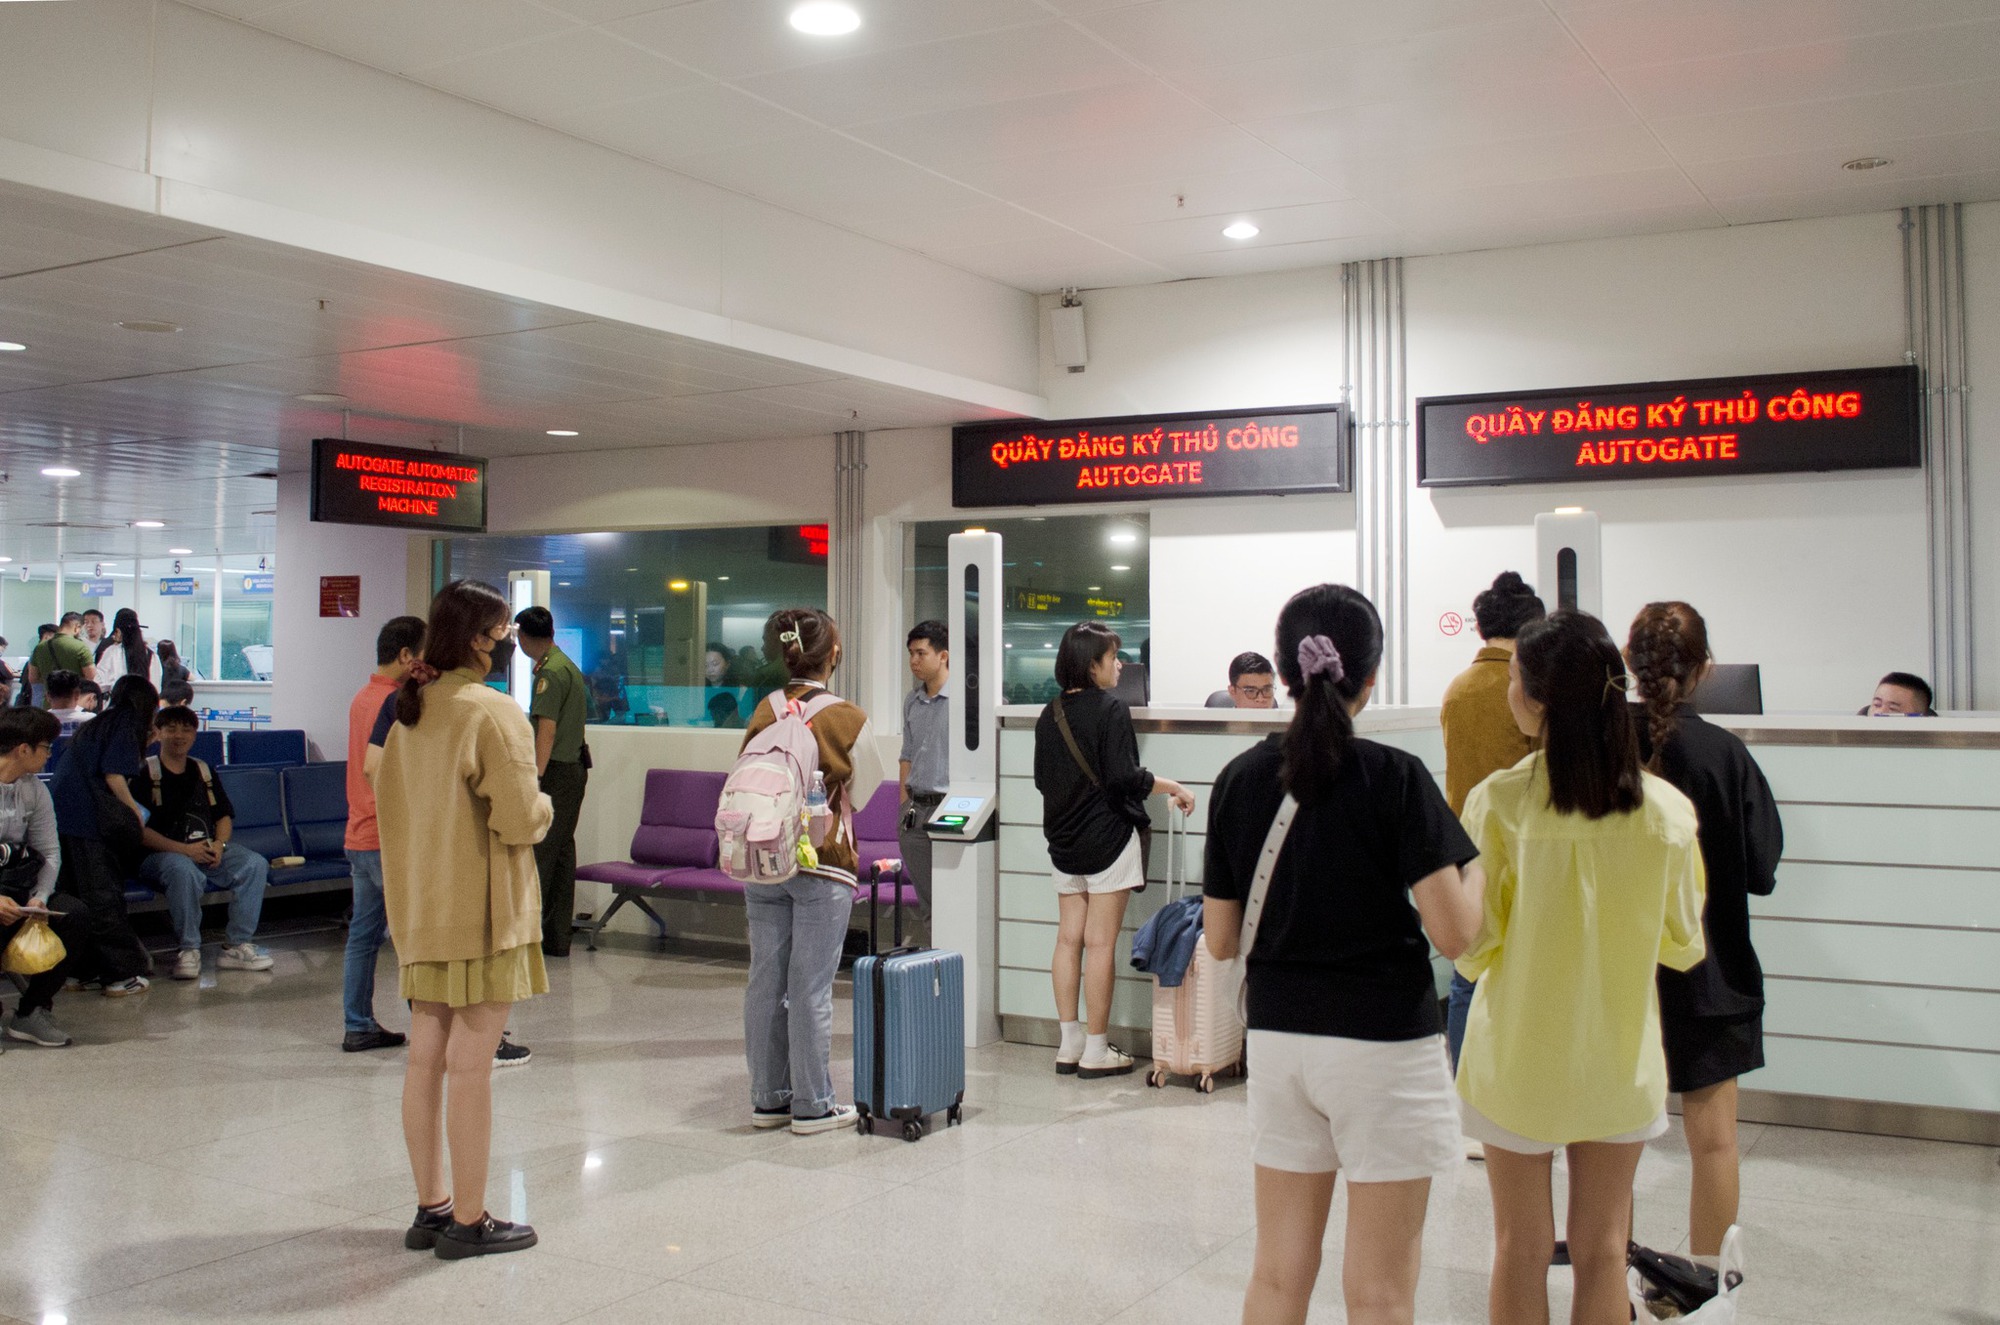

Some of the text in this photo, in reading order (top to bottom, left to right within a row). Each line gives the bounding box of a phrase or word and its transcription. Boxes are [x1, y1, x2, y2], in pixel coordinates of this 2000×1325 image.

[1466, 389, 1860, 441] QUẦY ĐĂNG KÝ THỦ CÔNG
[992, 424, 1300, 467] QUẦY ĐĂNG KÝ THỦ CÔNG
[1577, 434, 1738, 465] AUTOGATE
[336, 454, 478, 483] AUTOGATE AUTOMATIC
[1078, 461, 1202, 488] AUTOGATE
[360, 475, 456, 499] REGISTRATION
[378, 496, 438, 515] MACHINE
[22, 567, 28, 580] 7
[95, 564, 102, 577] 6
[174, 560, 181, 574] 5
[258, 557, 266, 571] 4
